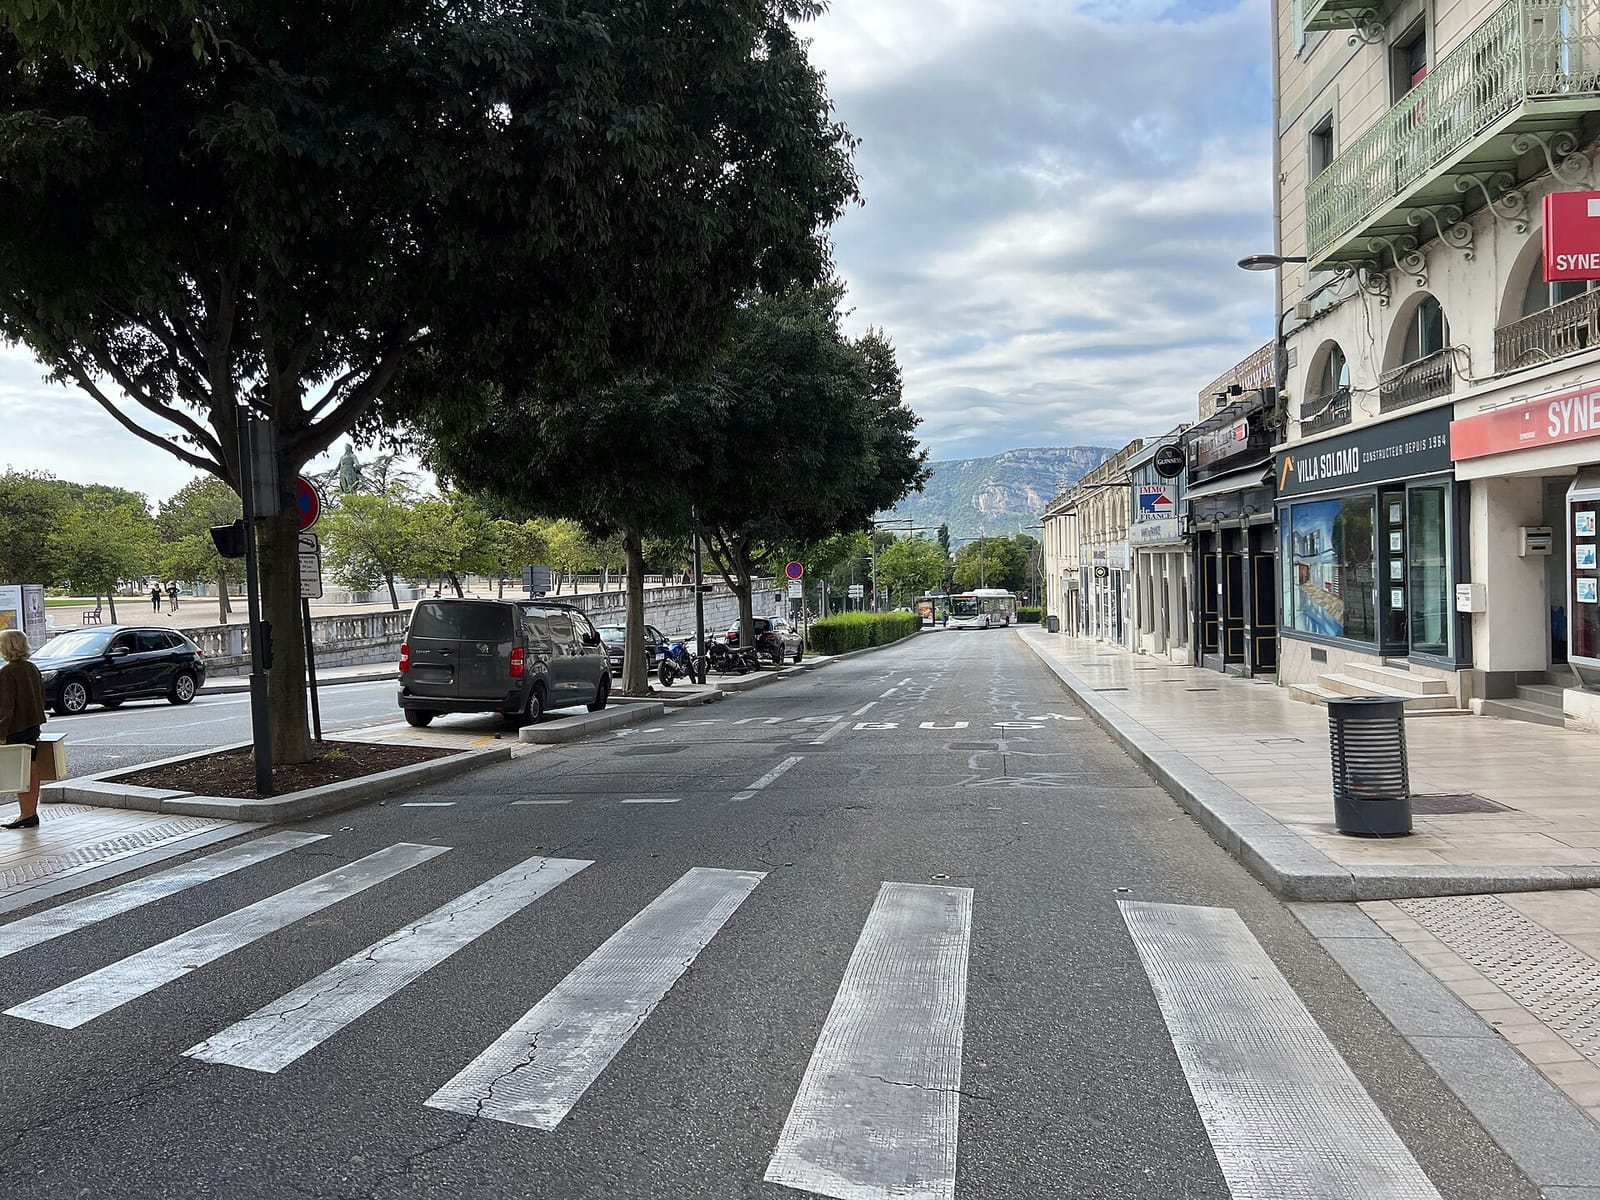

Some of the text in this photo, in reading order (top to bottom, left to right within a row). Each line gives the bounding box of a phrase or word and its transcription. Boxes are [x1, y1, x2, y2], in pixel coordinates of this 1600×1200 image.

[1556, 253, 1600, 271] SYNE
[1548, 391, 1600, 438] SYNE
[1297, 434, 1447, 483] VILLA SOLOMO CONSTRUCTEUR DEPUIS 1964
[852, 721, 1046, 730] BUS
